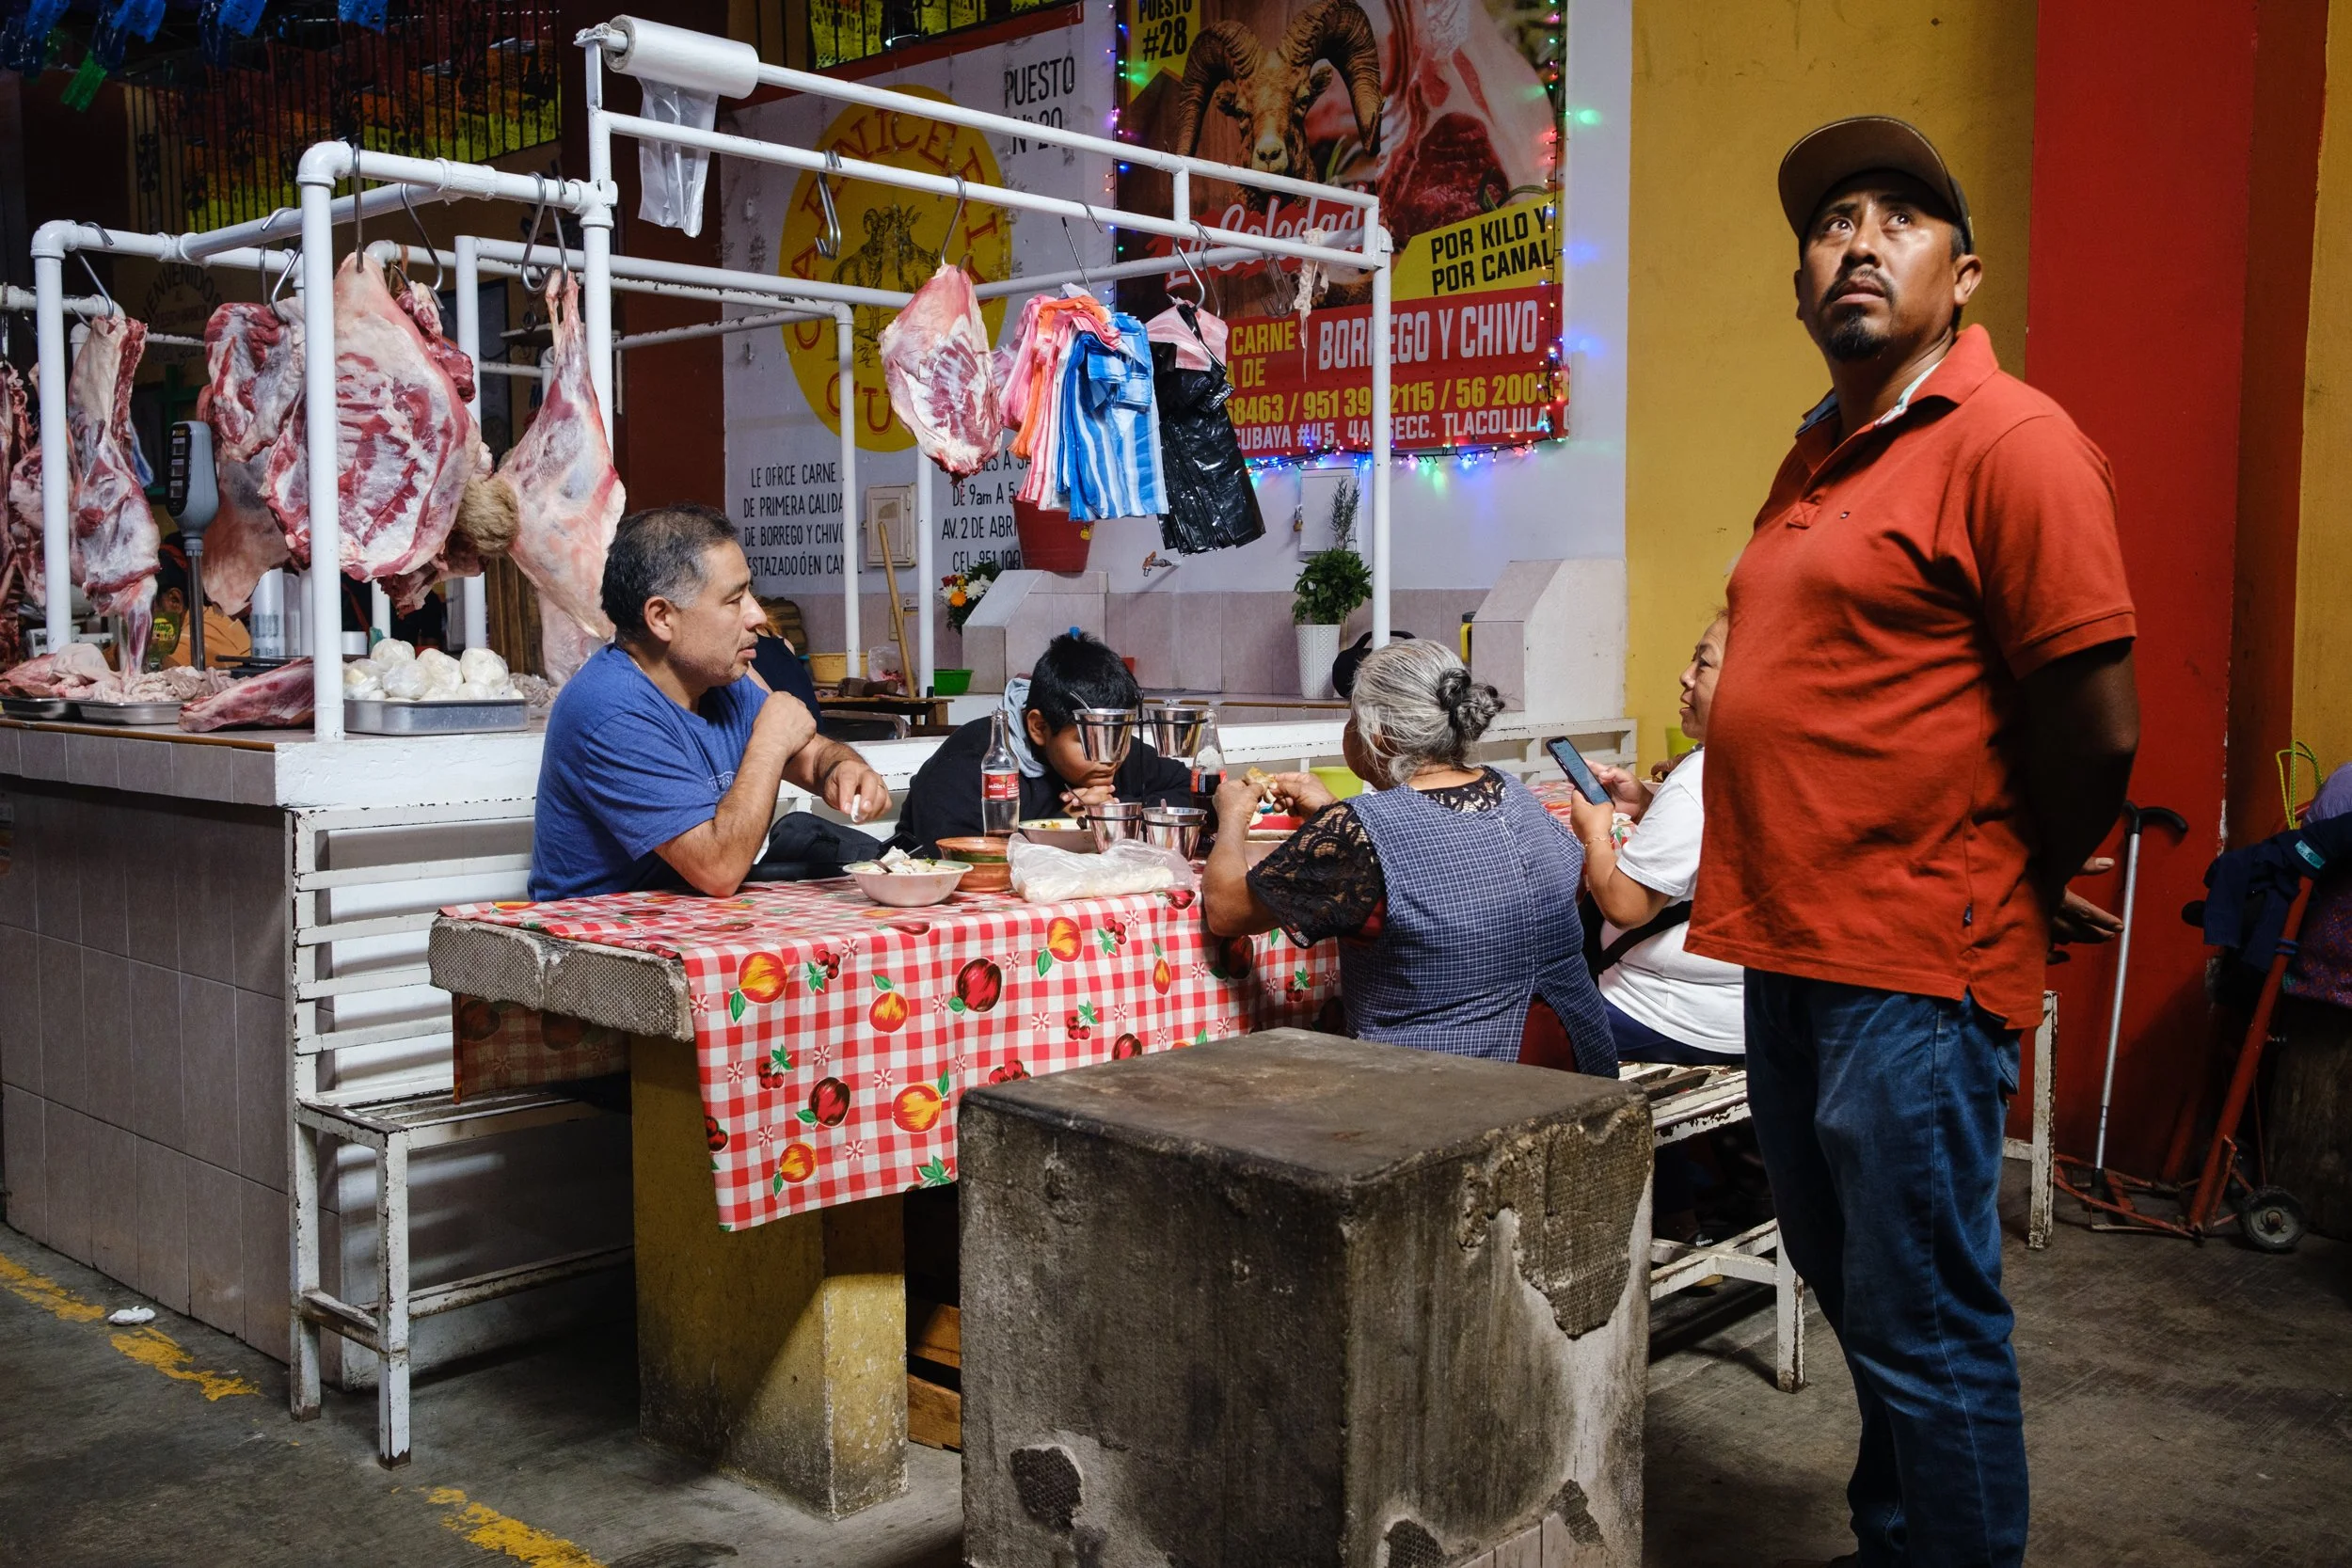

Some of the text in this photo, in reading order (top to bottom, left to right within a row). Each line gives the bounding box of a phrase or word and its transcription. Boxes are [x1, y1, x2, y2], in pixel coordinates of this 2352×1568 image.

[1143, 16, 1187, 62] #28
[1004, 55, 1074, 109] PUESTO
[1431, 205, 1549, 264] POR KILO Y
[1432, 239, 1554, 295] POR CANAL
[1232, 321, 1295, 356] CARNE
[1438, 308, 1454, 360] Y
[1460, 299, 1538, 358] CHIVO
[1242, 357, 1266, 388] DE
[1303, 389, 1339, 420] 951
[1344, 386, 1372, 418] 39
[1455, 376, 1486, 409] 56
[1391, 414, 1436, 440] ECC.
[751, 462, 836, 488] LE OFRCE CARNE
[743, 492, 843, 518] DE PRIMERA CALIDA
[953, 485, 965, 506] DE
[969, 483, 992, 505] 9am
[996, 483, 1005, 504] A
[744, 526, 755, 547] DE
[760, 524, 803, 546] BORREGO
[806, 524, 813, 545] Y
[942, 515, 1017, 540] AV. 2 DE ABRI
[746, 555, 798, 577] ESTAZADO
[808, 555, 821, 576] EN
[826, 554, 863, 575] CANL
